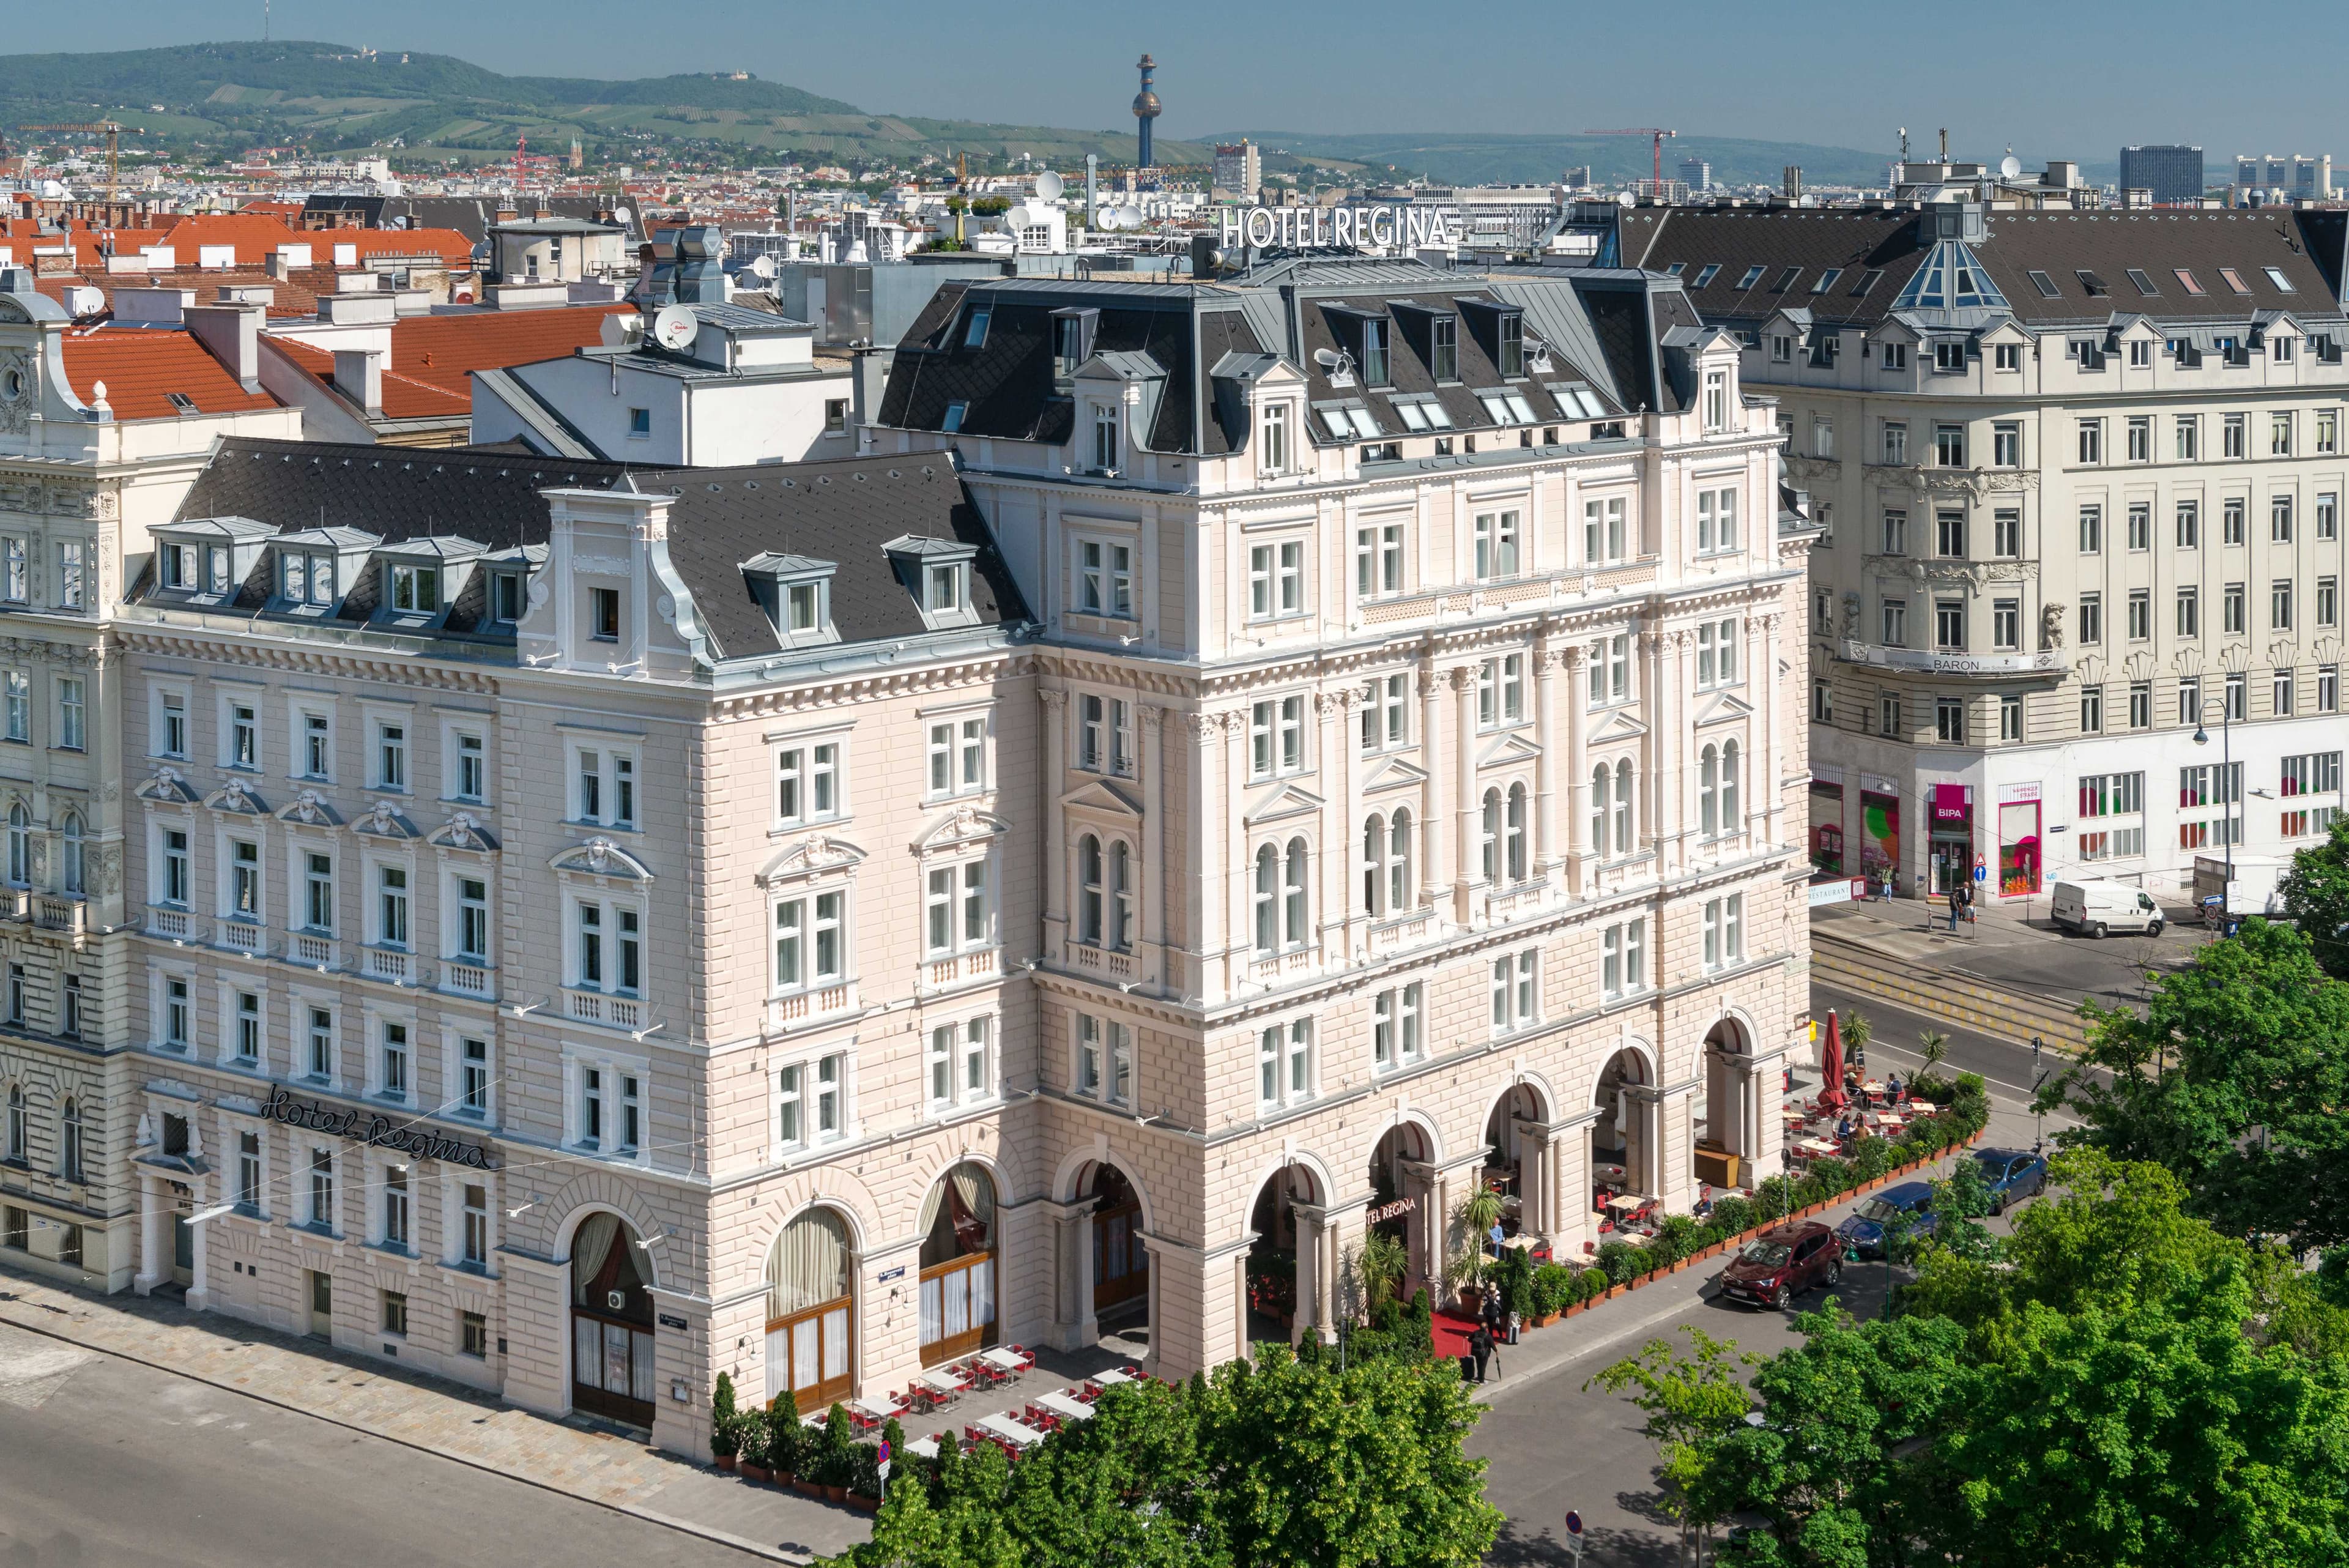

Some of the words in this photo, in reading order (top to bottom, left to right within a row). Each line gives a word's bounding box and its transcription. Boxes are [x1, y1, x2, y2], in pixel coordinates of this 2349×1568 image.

[1219, 206, 1328, 249] HOTEL
[1332, 205, 1450, 247] REGINA
[1934, 660, 1980, 670] BARON
[1939, 808, 1962, 817] BIPA
[1808, 887, 1849, 899] RESTAURANT
[259, 1083, 358, 1139] Hotel
[367, 1113, 497, 1170] Regina
[1366, 1209, 1381, 1225] TEL
[1382, 1197, 1416, 1219] REGINA
